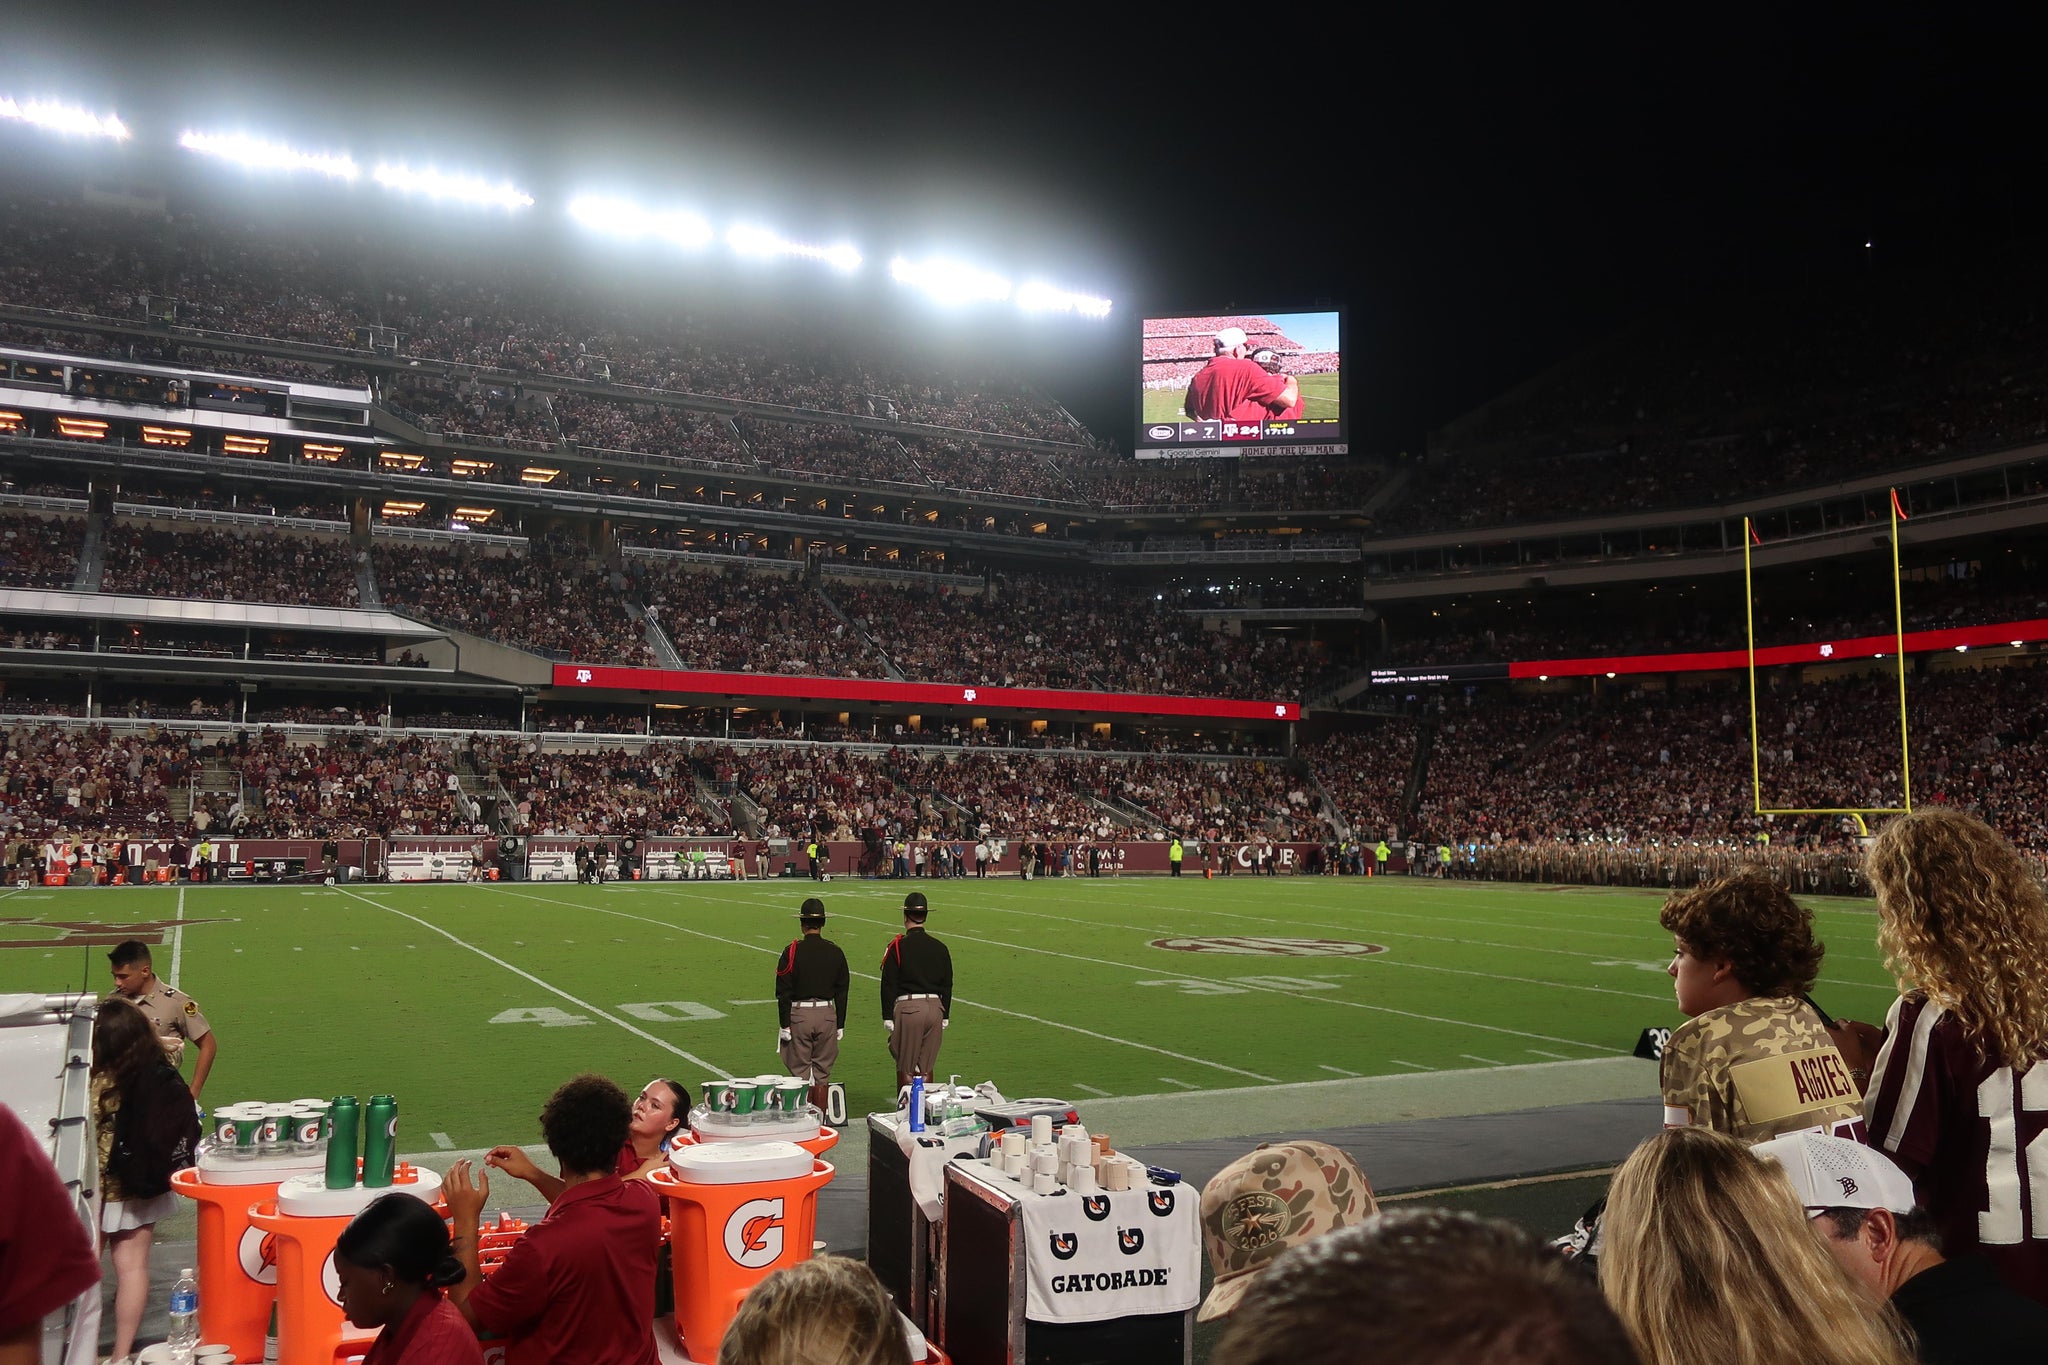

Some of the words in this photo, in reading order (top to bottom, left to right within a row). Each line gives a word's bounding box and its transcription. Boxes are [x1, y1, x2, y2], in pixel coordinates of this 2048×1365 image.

[1204, 427, 1214, 435] 7
[1240, 426, 1260, 435] 24
[1167, 449, 1194, 458] Google
[1195, 448, 1221, 457] Gemini
[1242, 447, 1265, 456] HOME
[1267, 447, 1277, 456] OF
[1279, 447, 1296, 455] THE
[1316, 446, 1335, 454] MAN
[17, 880, 30, 890] 50
[324, 876, 335, 886] 40
[488, 1001, 729, 1028] 40
[1789, 1054, 1852, 1104] AGGIES
[723, 1196, 785, 1269] G
[1241, 1229, 1278, 1249] 2026
[1051, 1268, 1168, 1294] GATORADE
